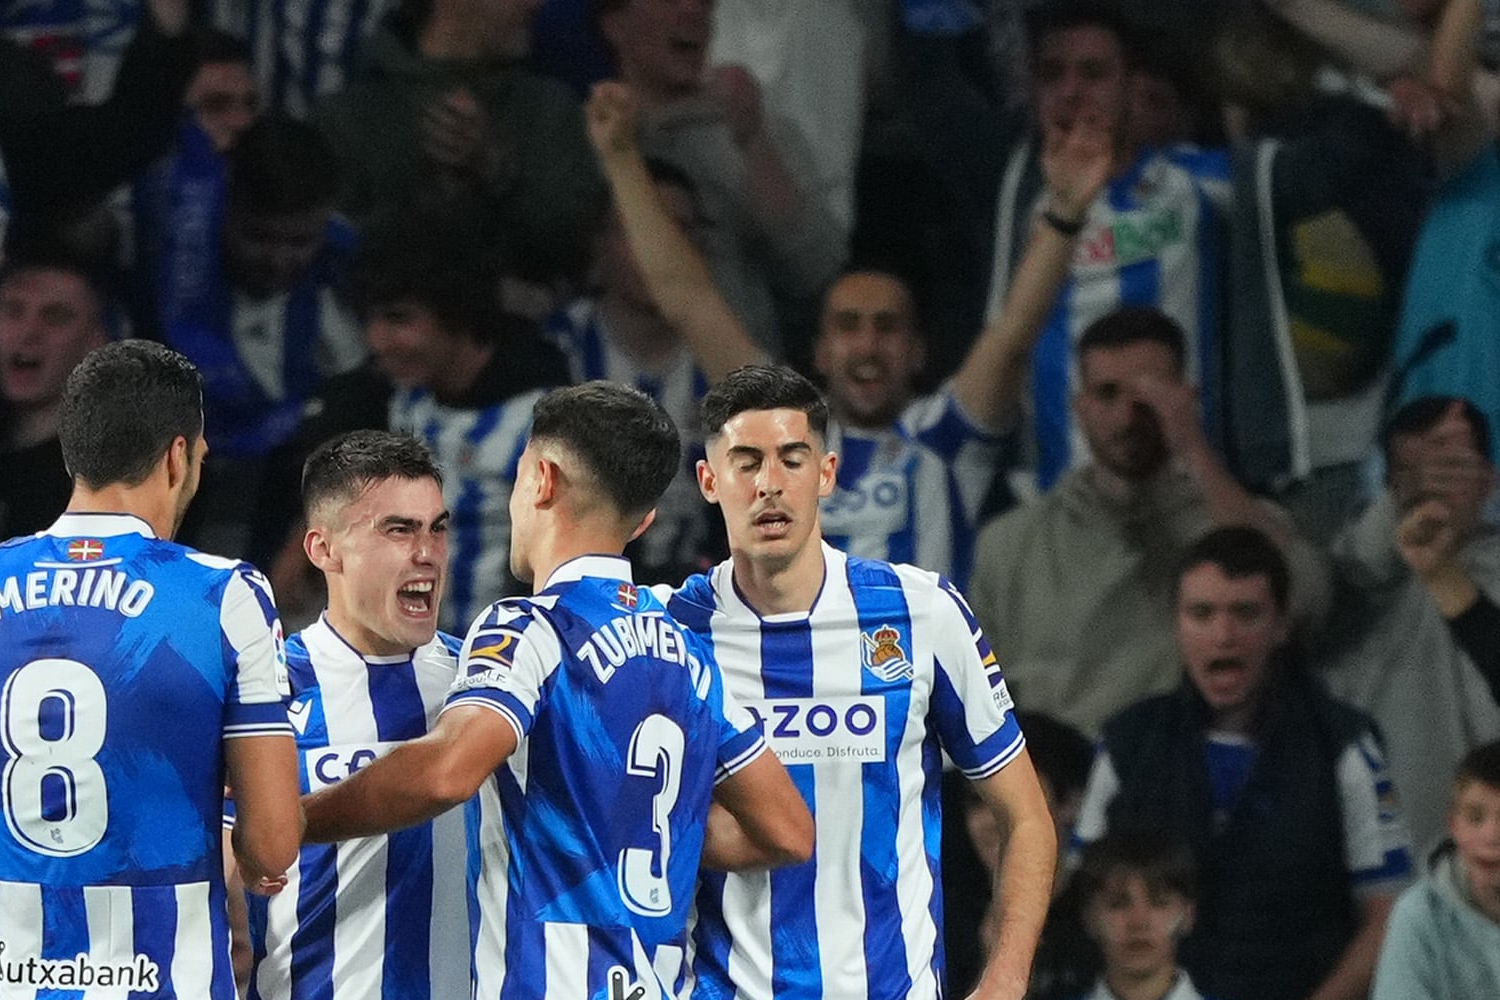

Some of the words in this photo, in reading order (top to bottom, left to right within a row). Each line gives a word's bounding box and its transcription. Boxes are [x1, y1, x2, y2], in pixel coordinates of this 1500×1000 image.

[0, 658, 108, 858] 8
[315, 748, 377, 785] CA
[774, 748, 823, 759] onduce.
[617, 713, 685, 918] 3
